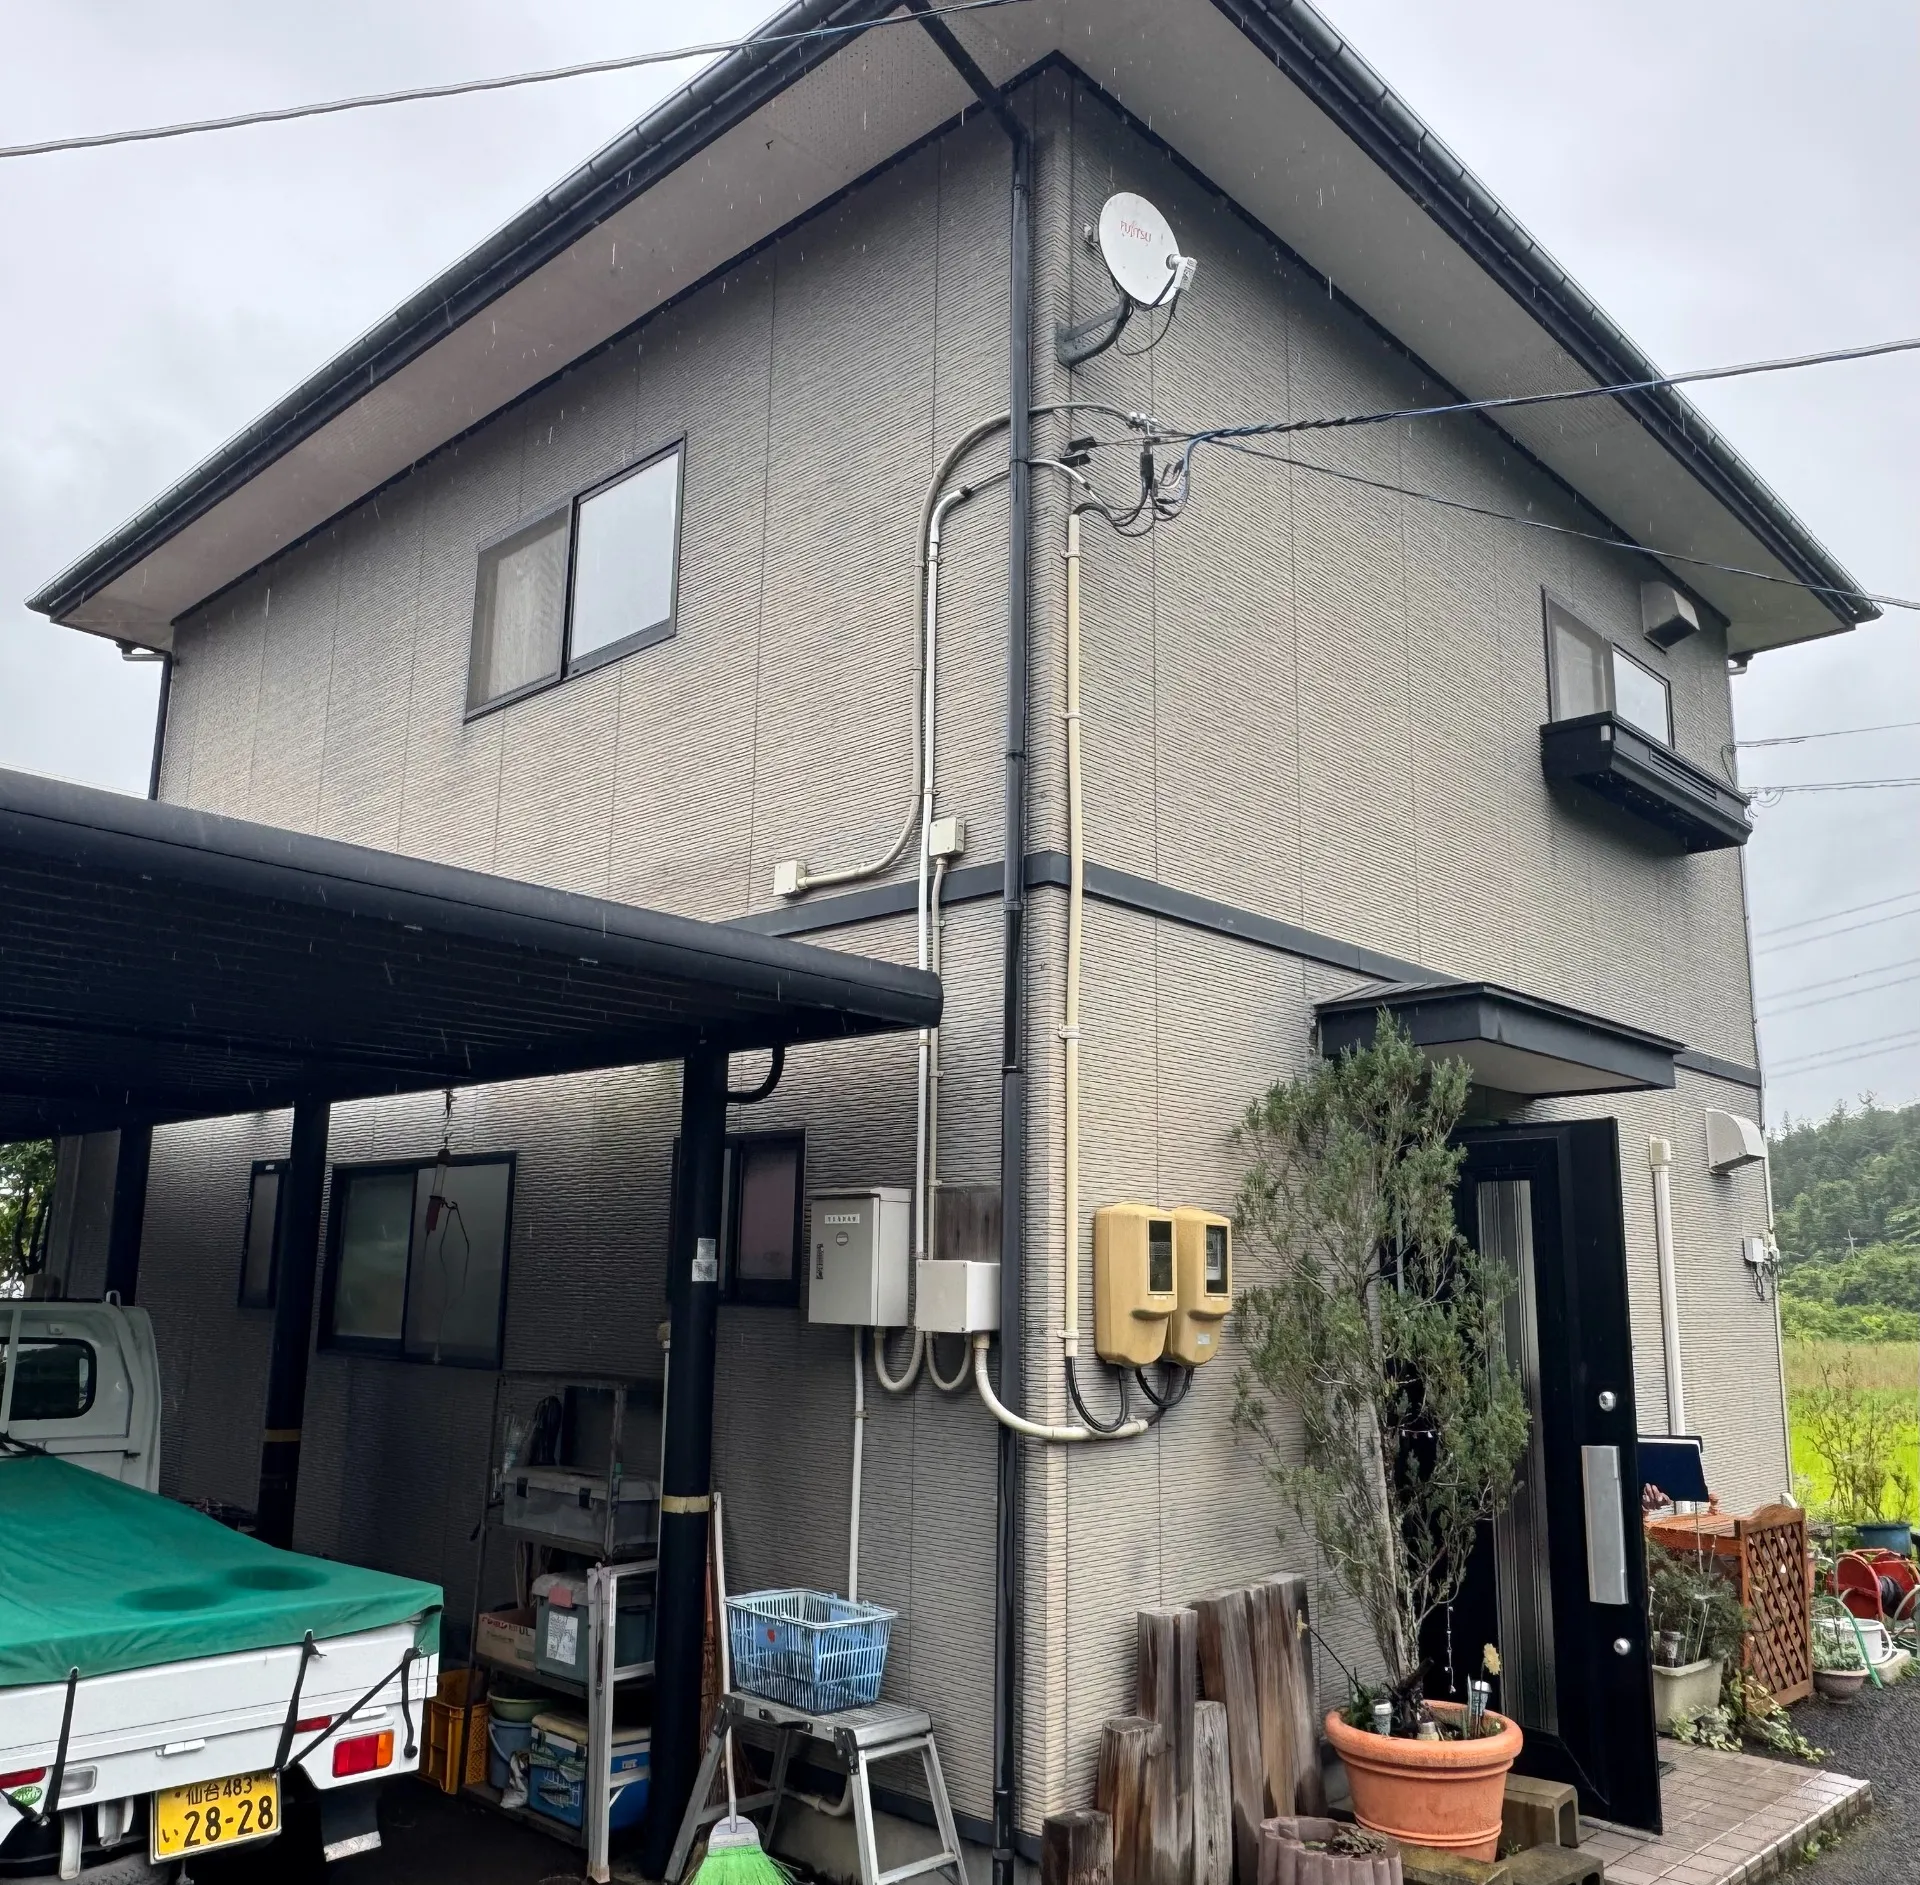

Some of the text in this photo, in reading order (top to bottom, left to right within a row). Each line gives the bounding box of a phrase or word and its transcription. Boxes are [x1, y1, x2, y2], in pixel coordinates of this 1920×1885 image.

[1120, 220, 1152, 242] FUJITSU
[223, 1776, 253, 1798] 483
[162, 1795, 274, 1848] い 28-28
